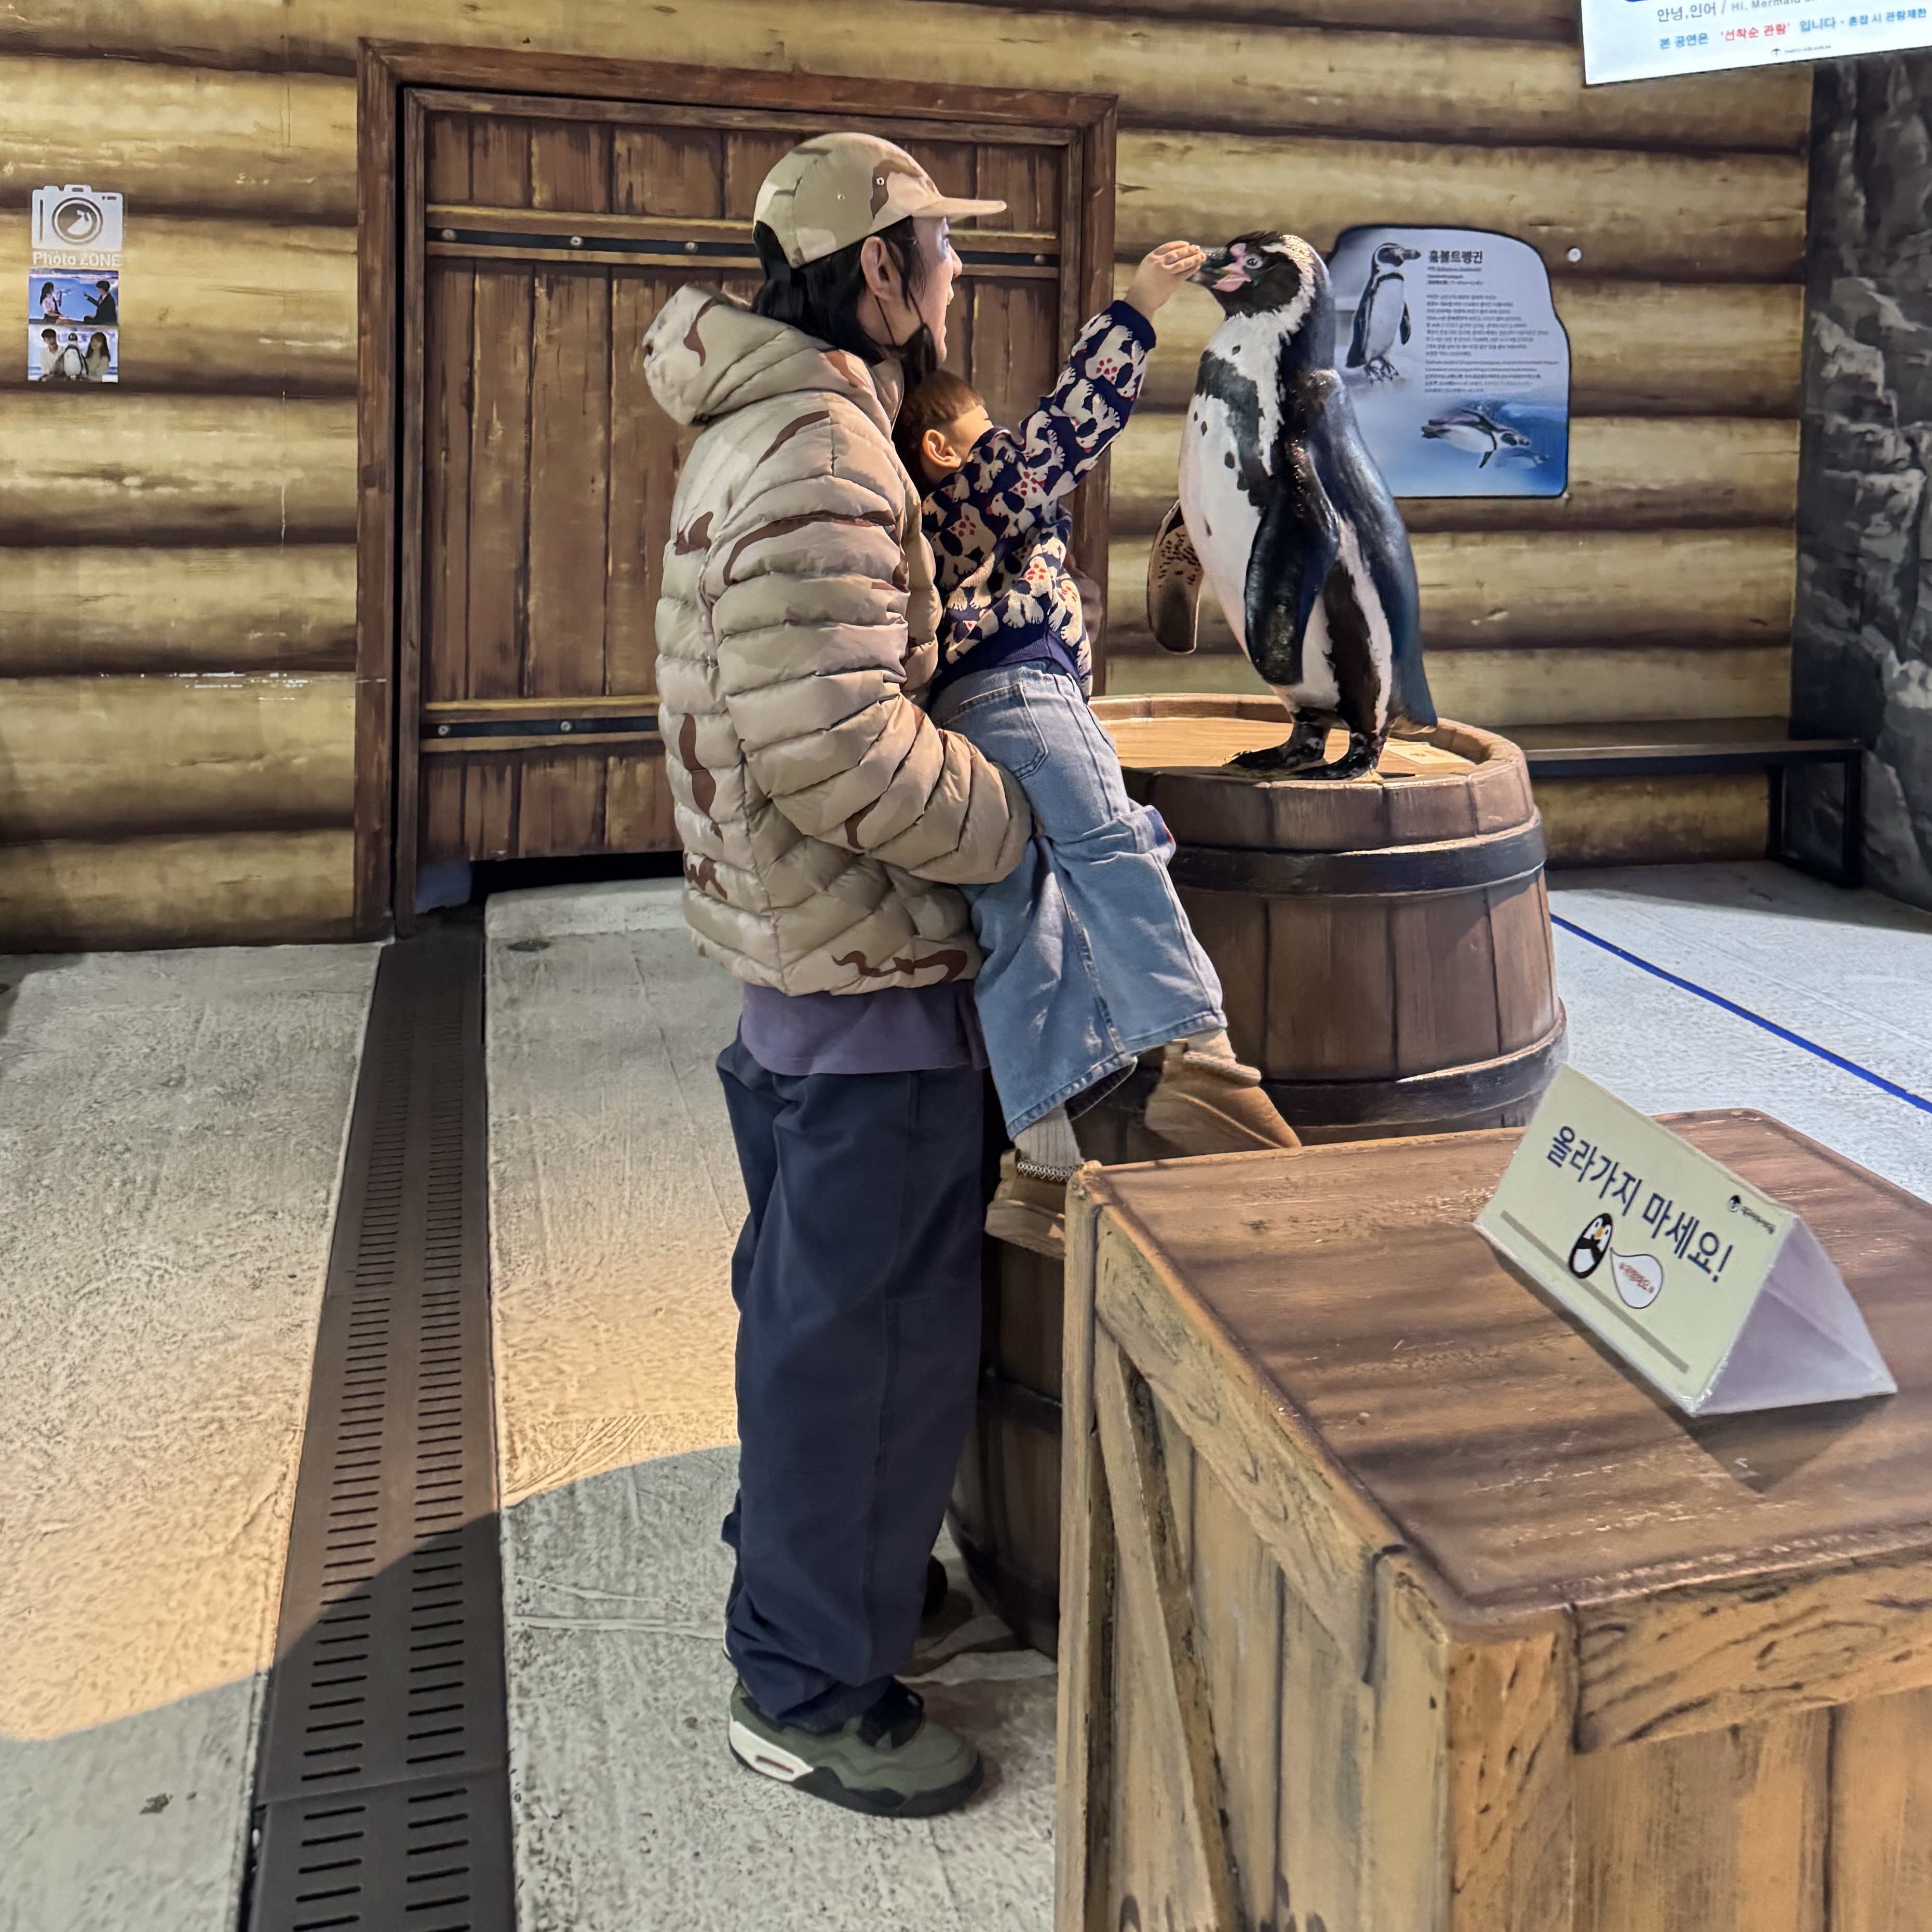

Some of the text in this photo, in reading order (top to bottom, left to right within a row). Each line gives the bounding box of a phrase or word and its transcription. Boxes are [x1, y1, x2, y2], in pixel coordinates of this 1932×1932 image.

[1657, 2, 1716, 22] 안녕,인어
[1660, 38, 1670, 49] 본
[1676, 33, 1708, 48] 공연은
[1800, 17, 1835, 32] 입니다
[1849, 15, 1868, 26] 혼잡
[1872, 12, 1881, 22] 시
[1886, 8, 1927, 22] 관람제한
[33, 251, 120, 267] Photo ZONE
[1546, 1126, 1733, 1283] 올라가지 마세요!
